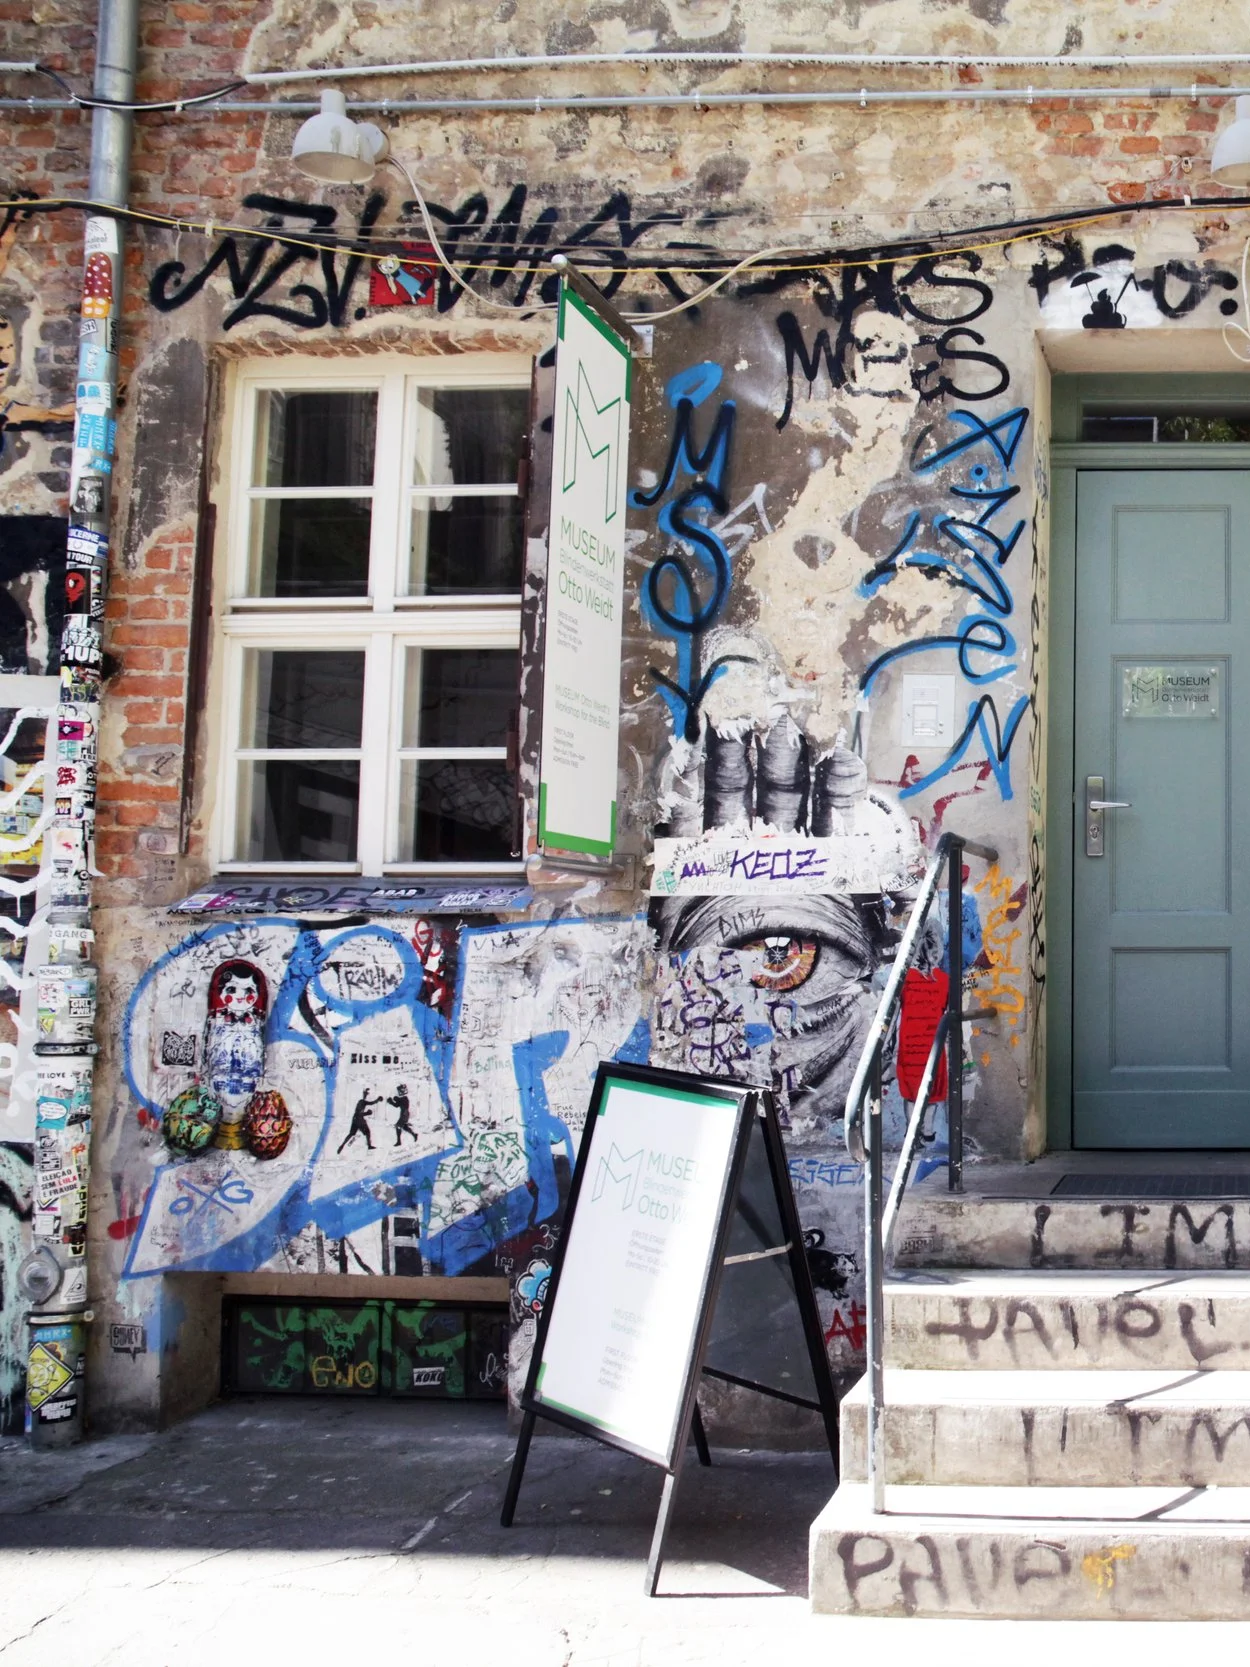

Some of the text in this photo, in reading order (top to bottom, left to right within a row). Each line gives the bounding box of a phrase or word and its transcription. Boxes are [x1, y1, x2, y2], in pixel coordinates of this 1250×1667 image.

[561, 515, 615, 573] MUSEUM
[559, 571, 613, 622] Otto Weidt
[1162, 676, 1210, 686] MUSEUM
[70, 1000, 91, 1008] GRL
[638, 1194, 669, 1220] Otto
